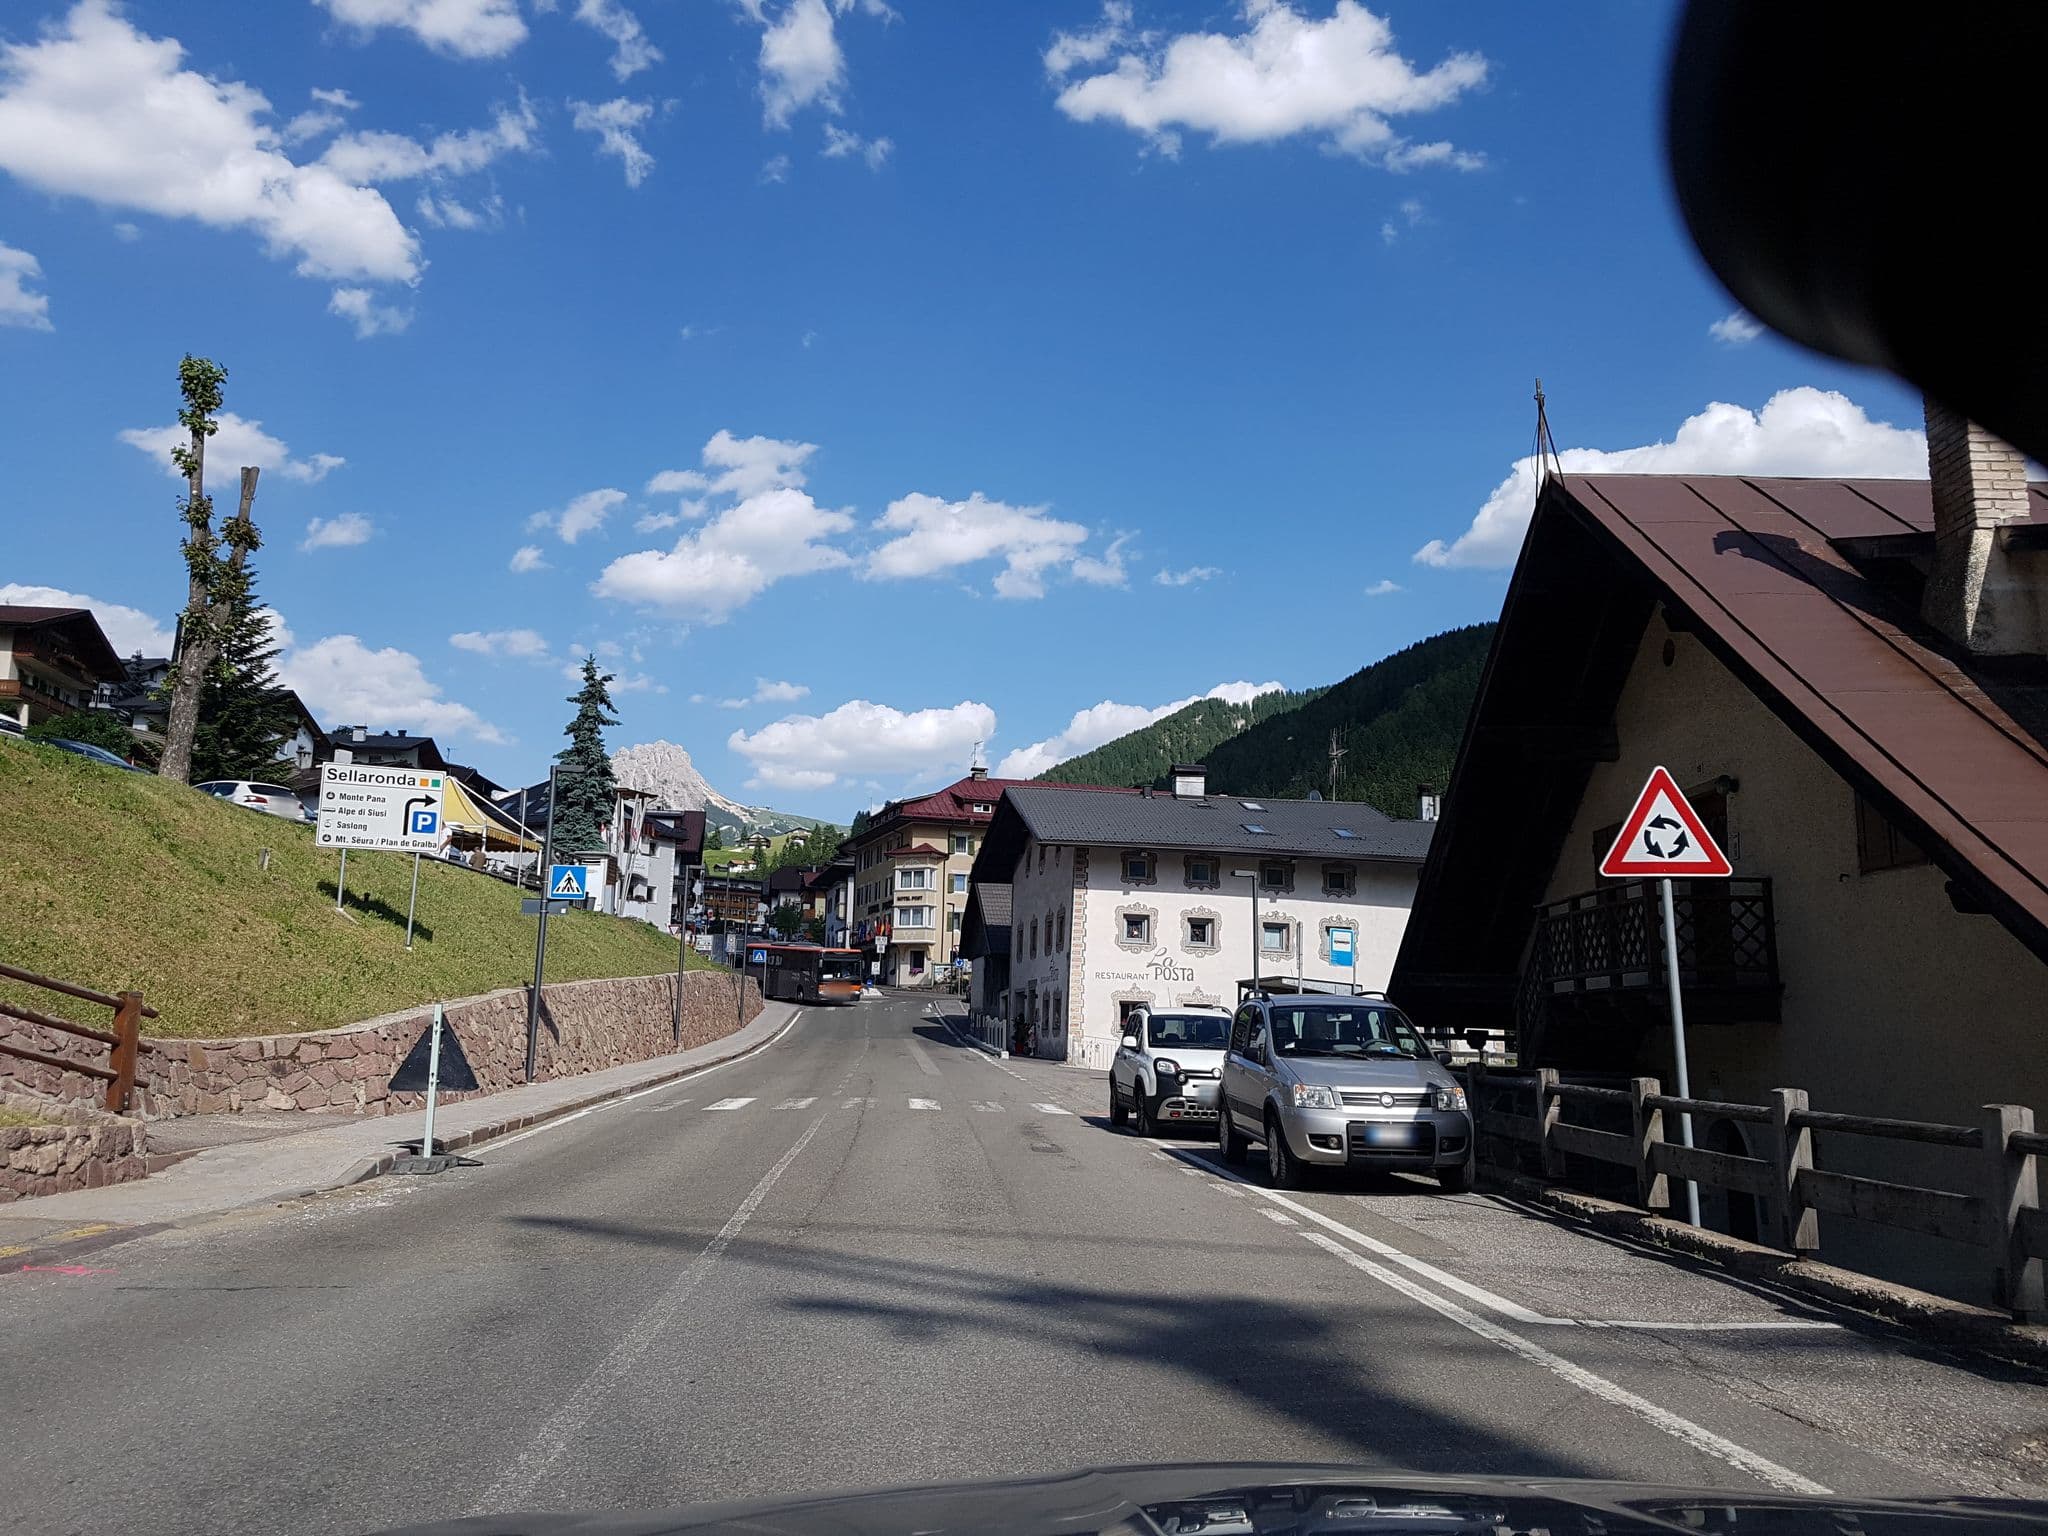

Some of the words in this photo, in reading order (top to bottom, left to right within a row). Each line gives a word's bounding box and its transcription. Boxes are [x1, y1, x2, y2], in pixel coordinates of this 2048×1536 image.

[326, 768, 416, 786] Sellaronda
[339, 792, 364, 802] Monte
[366, 794, 386, 803] Pana
[338, 807, 356, 816] Alpe
[358, 807, 366, 816] di
[367, 808, 387, 817] Siusi
[336, 821, 368, 832] Saslong
[417, 814, 432, 830] P
[335, 835, 349, 844] Mt.
[381, 838, 398, 847] Plan
[400, 839, 410, 847] de
[411, 840, 438, 849] Gralba
[1146, 946, 1178, 969] La
[1095, 971, 1150, 980] RESTAURANT
